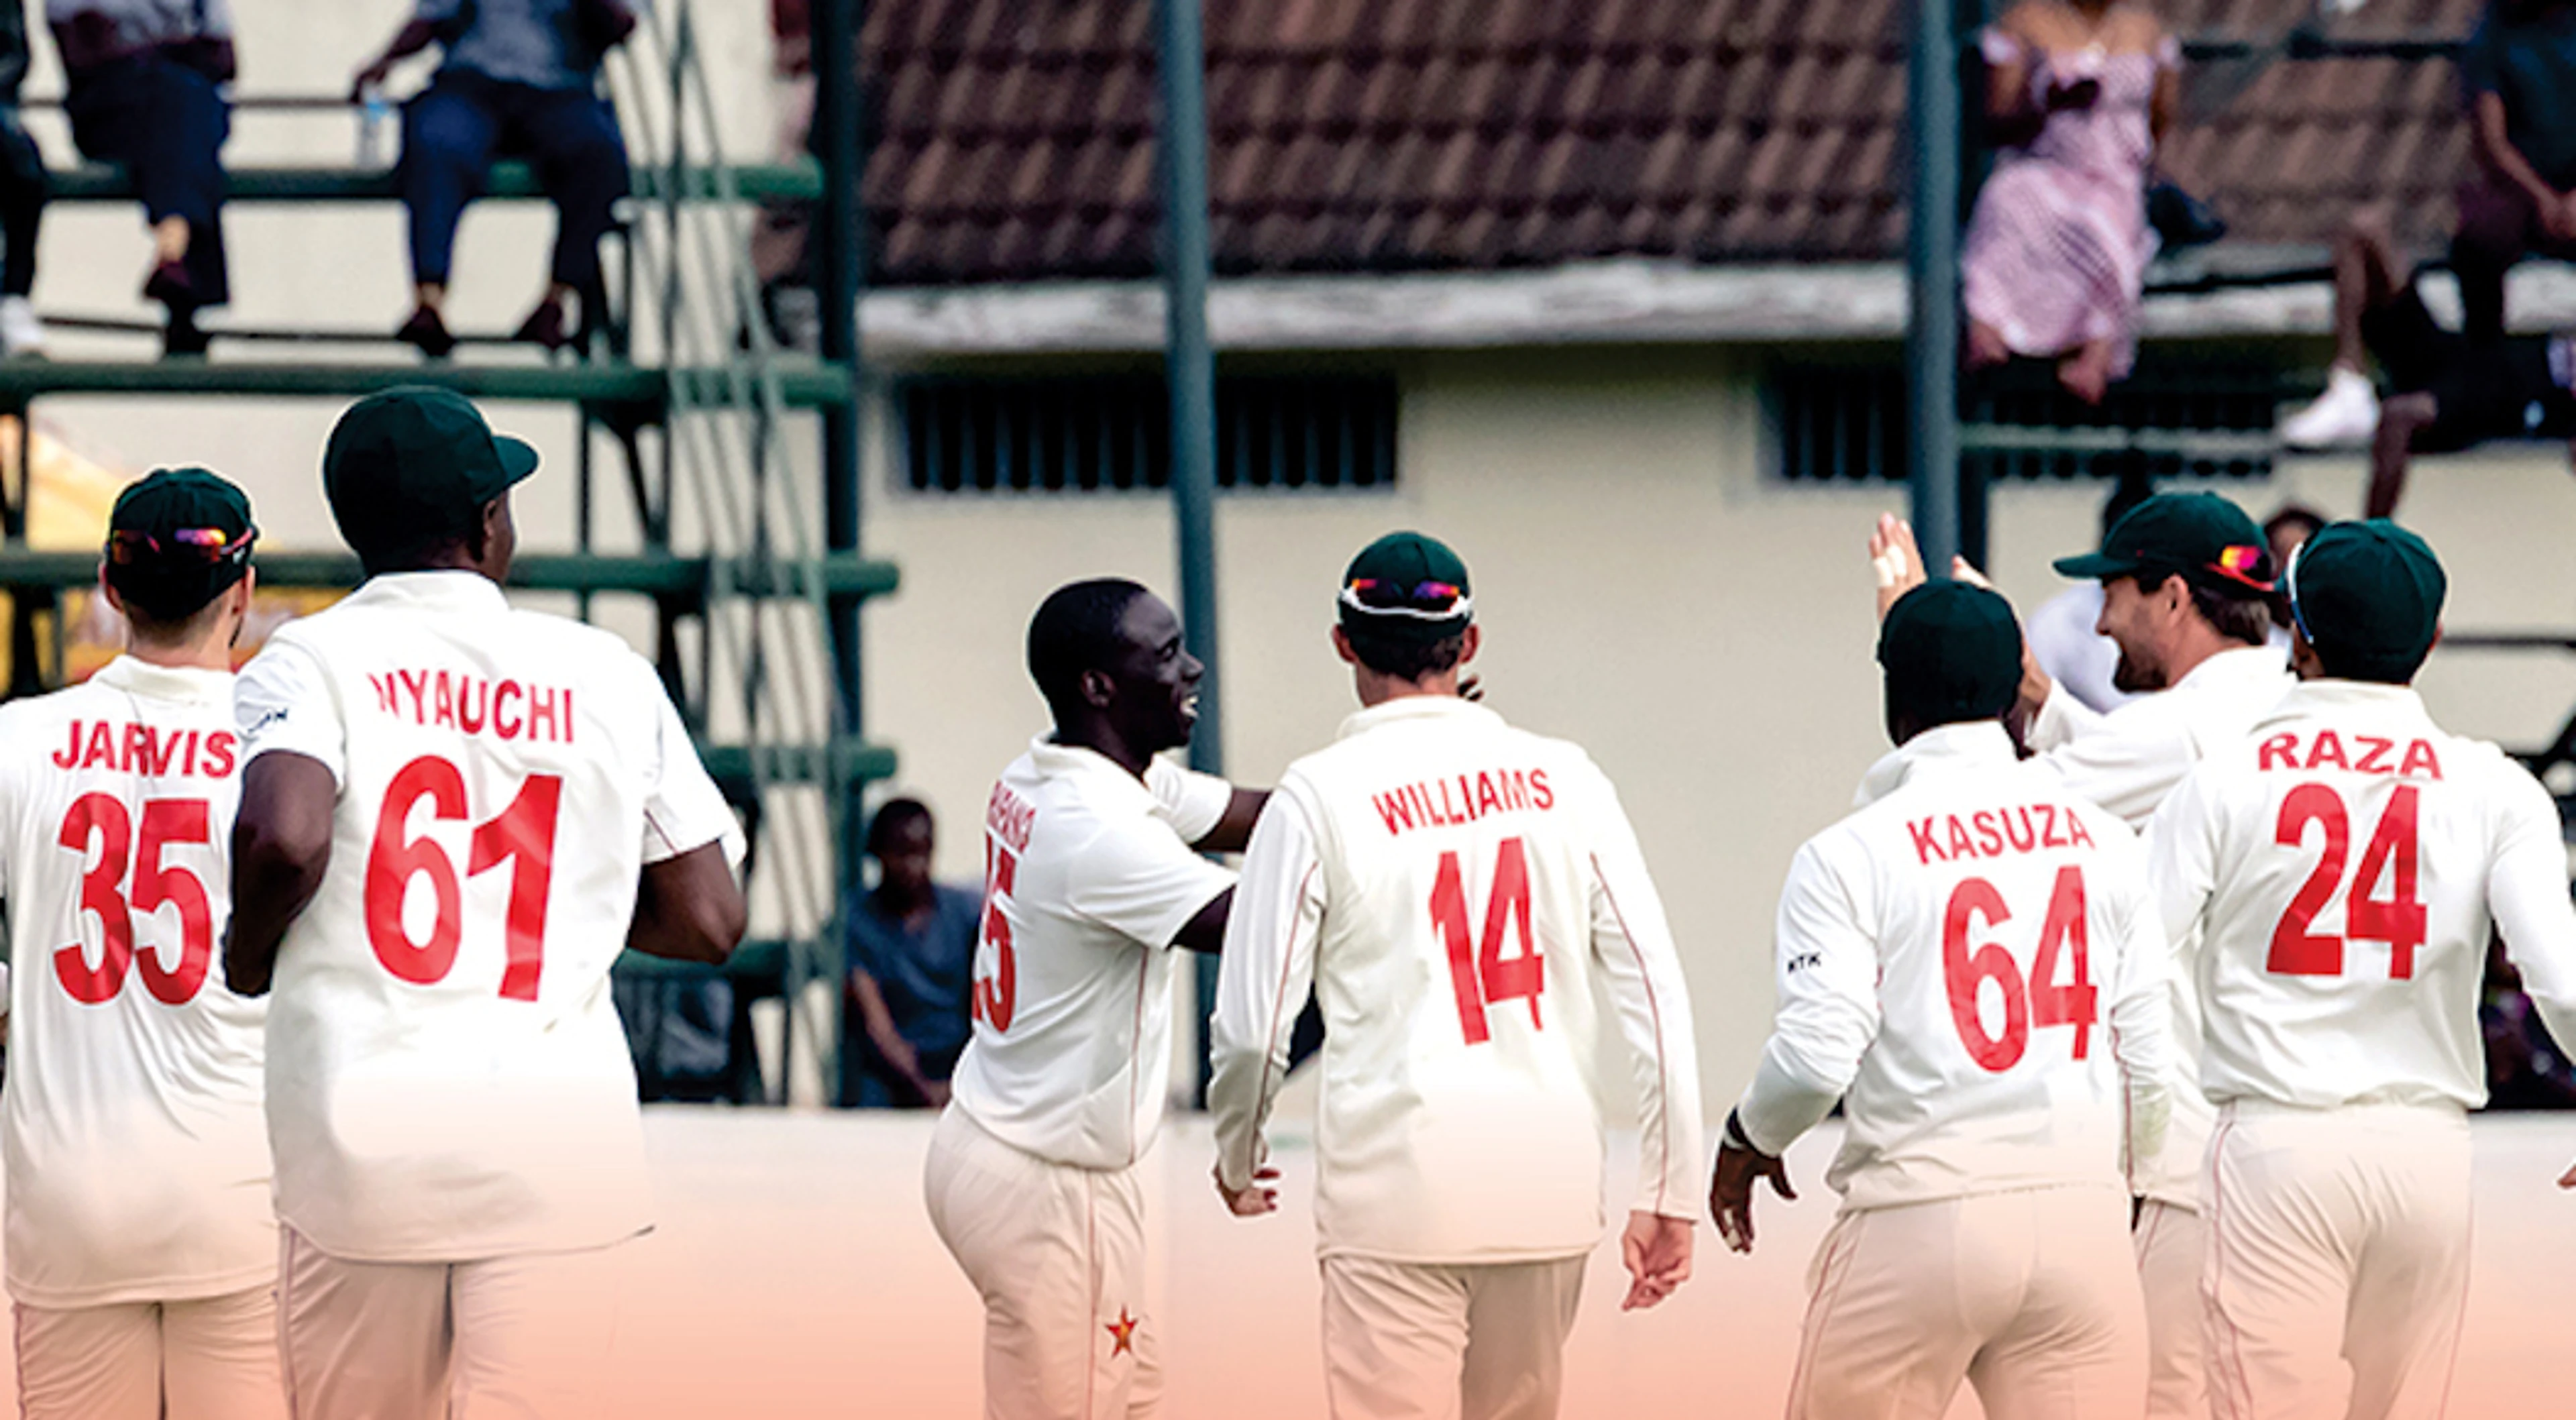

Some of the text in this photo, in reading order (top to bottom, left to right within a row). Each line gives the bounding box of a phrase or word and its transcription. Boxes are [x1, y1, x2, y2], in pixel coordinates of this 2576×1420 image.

[52, 719, 237, 779] JARVIS
[366, 669, 574, 744] NYAUCHI
[1371, 768, 1554, 836] WILLIAMS
[2258, 729, 2443, 780] RAZA
[53, 791, 213, 1005] 35
[362, 754, 563, 1003] 61
[972, 829, 1016, 1033] 5
[1906, 804, 2095, 865] KASUZA
[2265, 781, 2428, 981] 24
[1428, 836, 1545, 1046] 14
[1942, 865, 2098, 1073] 64
